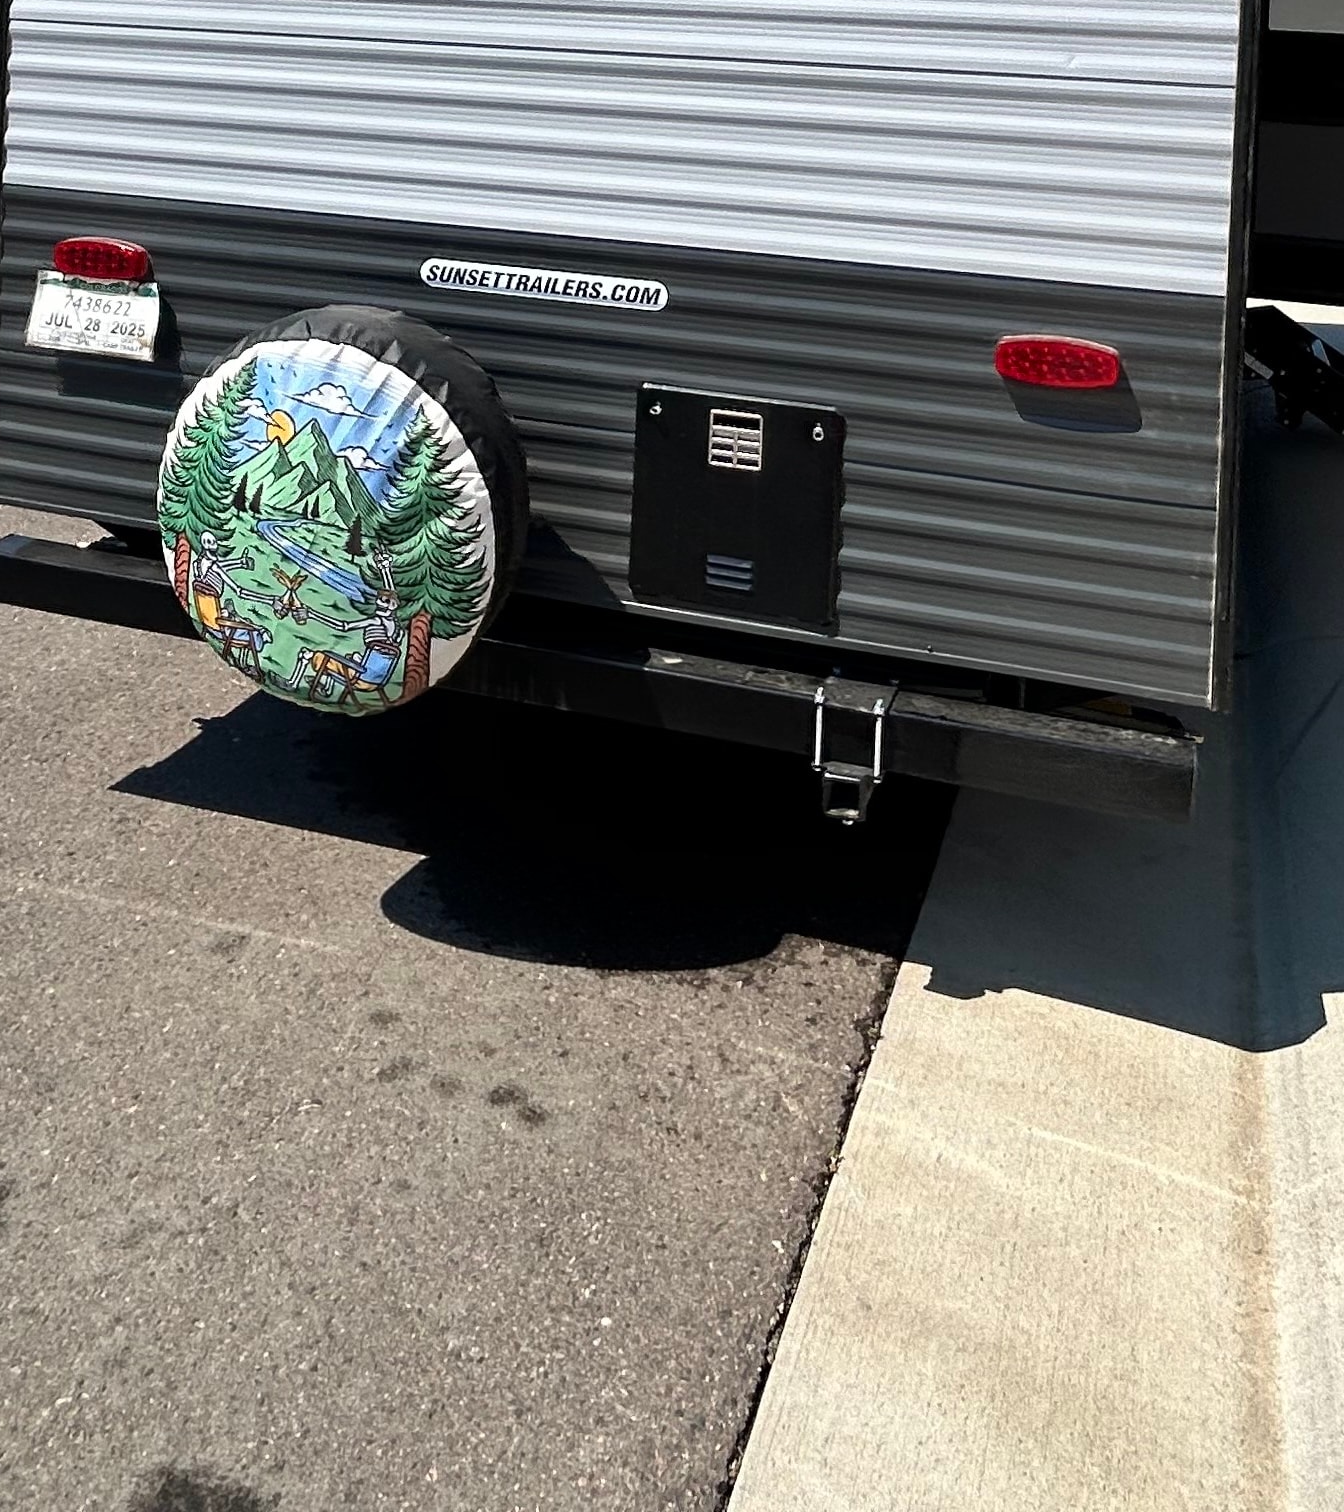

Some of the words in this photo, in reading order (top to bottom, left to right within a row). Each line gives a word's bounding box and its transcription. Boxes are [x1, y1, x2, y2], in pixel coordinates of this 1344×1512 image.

[426, 264, 661, 306] SUNSETTRAILERS.COM
[45, 312, 72, 329] JUL
[84, 317, 101, 332] 28
[110, 321, 145, 338] 2025
